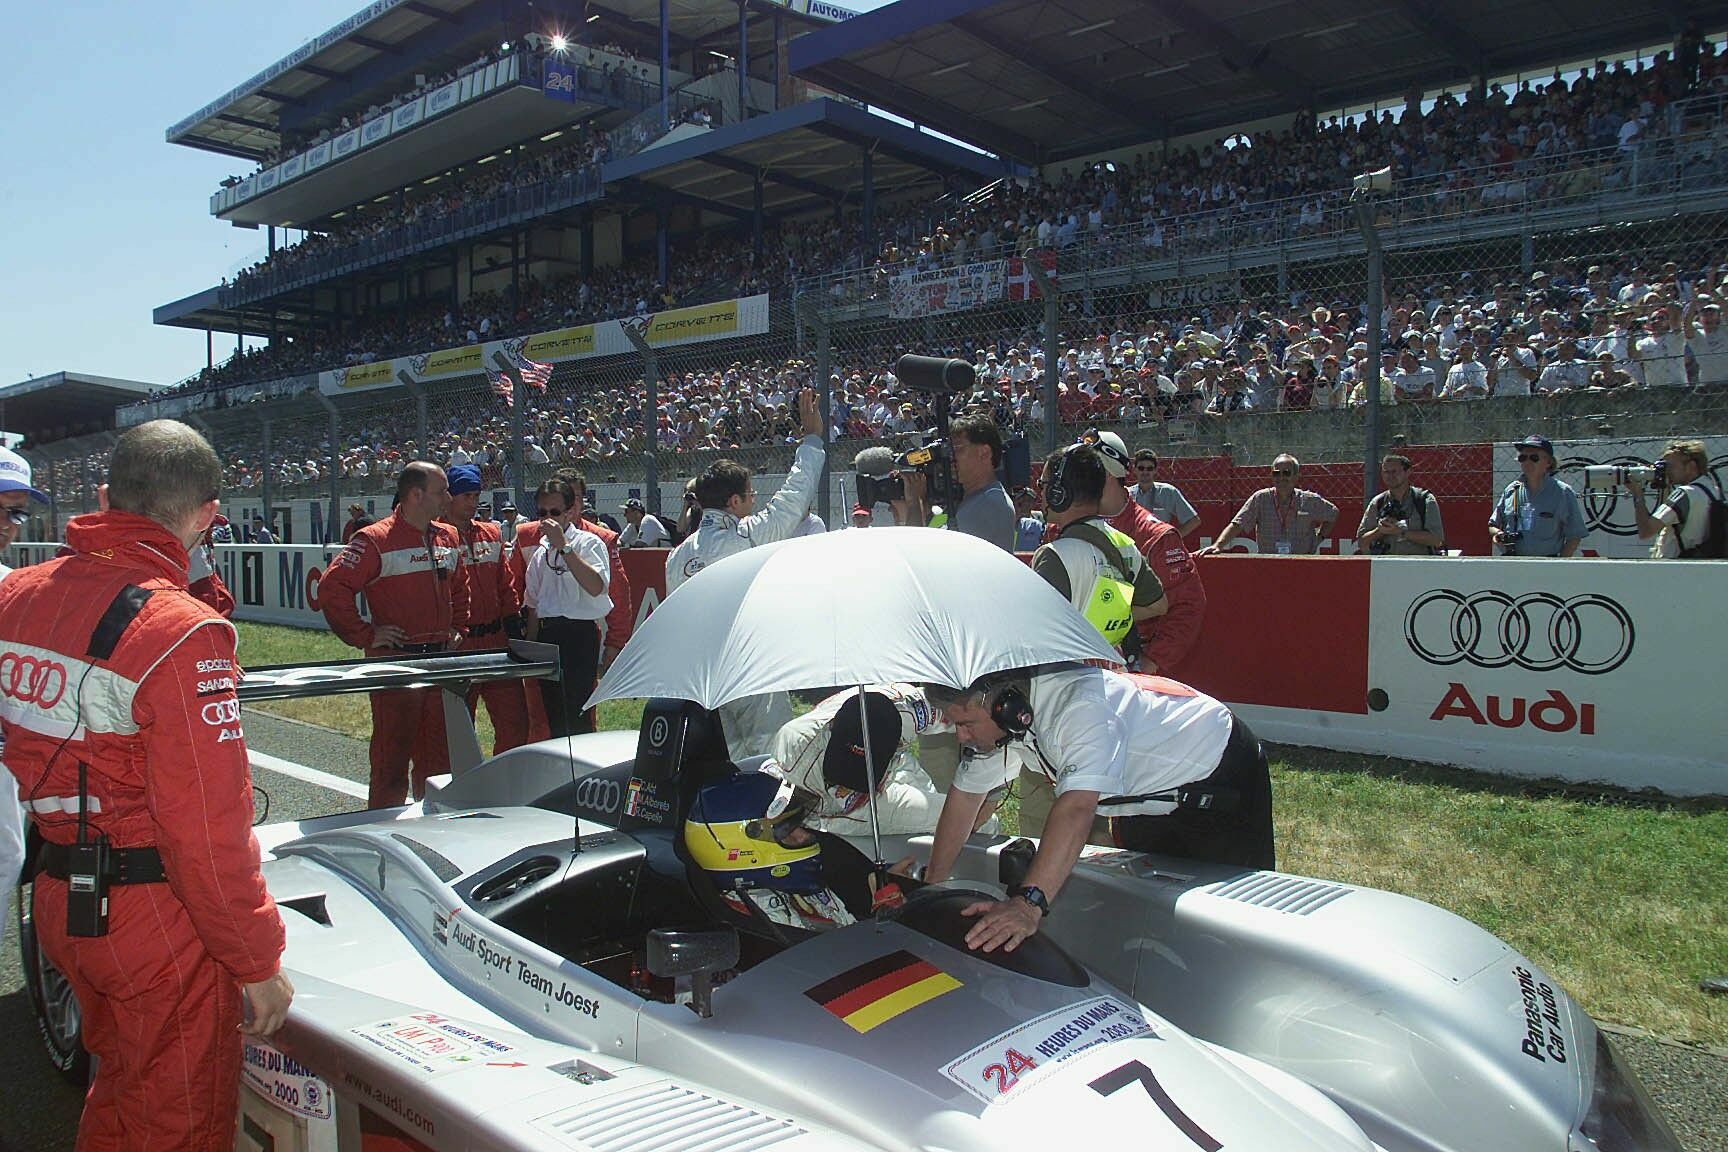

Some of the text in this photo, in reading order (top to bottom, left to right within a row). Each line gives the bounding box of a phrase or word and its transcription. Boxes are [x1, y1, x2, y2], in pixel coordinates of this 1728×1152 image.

[546, 72, 573, 92] 24
[655, 311, 736, 332] CORVETTE
[217, 727, 243, 743] Au
[1429, 682, 1595, 735] Audi
[452, 923, 600, 1019] Audi Sport Team Joest
[1100, 1022, 1134, 1040] 2000
[1511, 965, 1546, 1063] Panasonic
[1535, 981, 1567, 1064] Car Audio
[244, 1043, 267, 1070] EURES
[267, 1051, 281, 1073] DU
[983, 1001, 1121, 1095] 24 HEURES DU MANS
[273, 1080, 299, 1106] 2000
[344, 1071, 435, 1137] www.audi.com
[1086, 1059, 1225, 1152] 7
